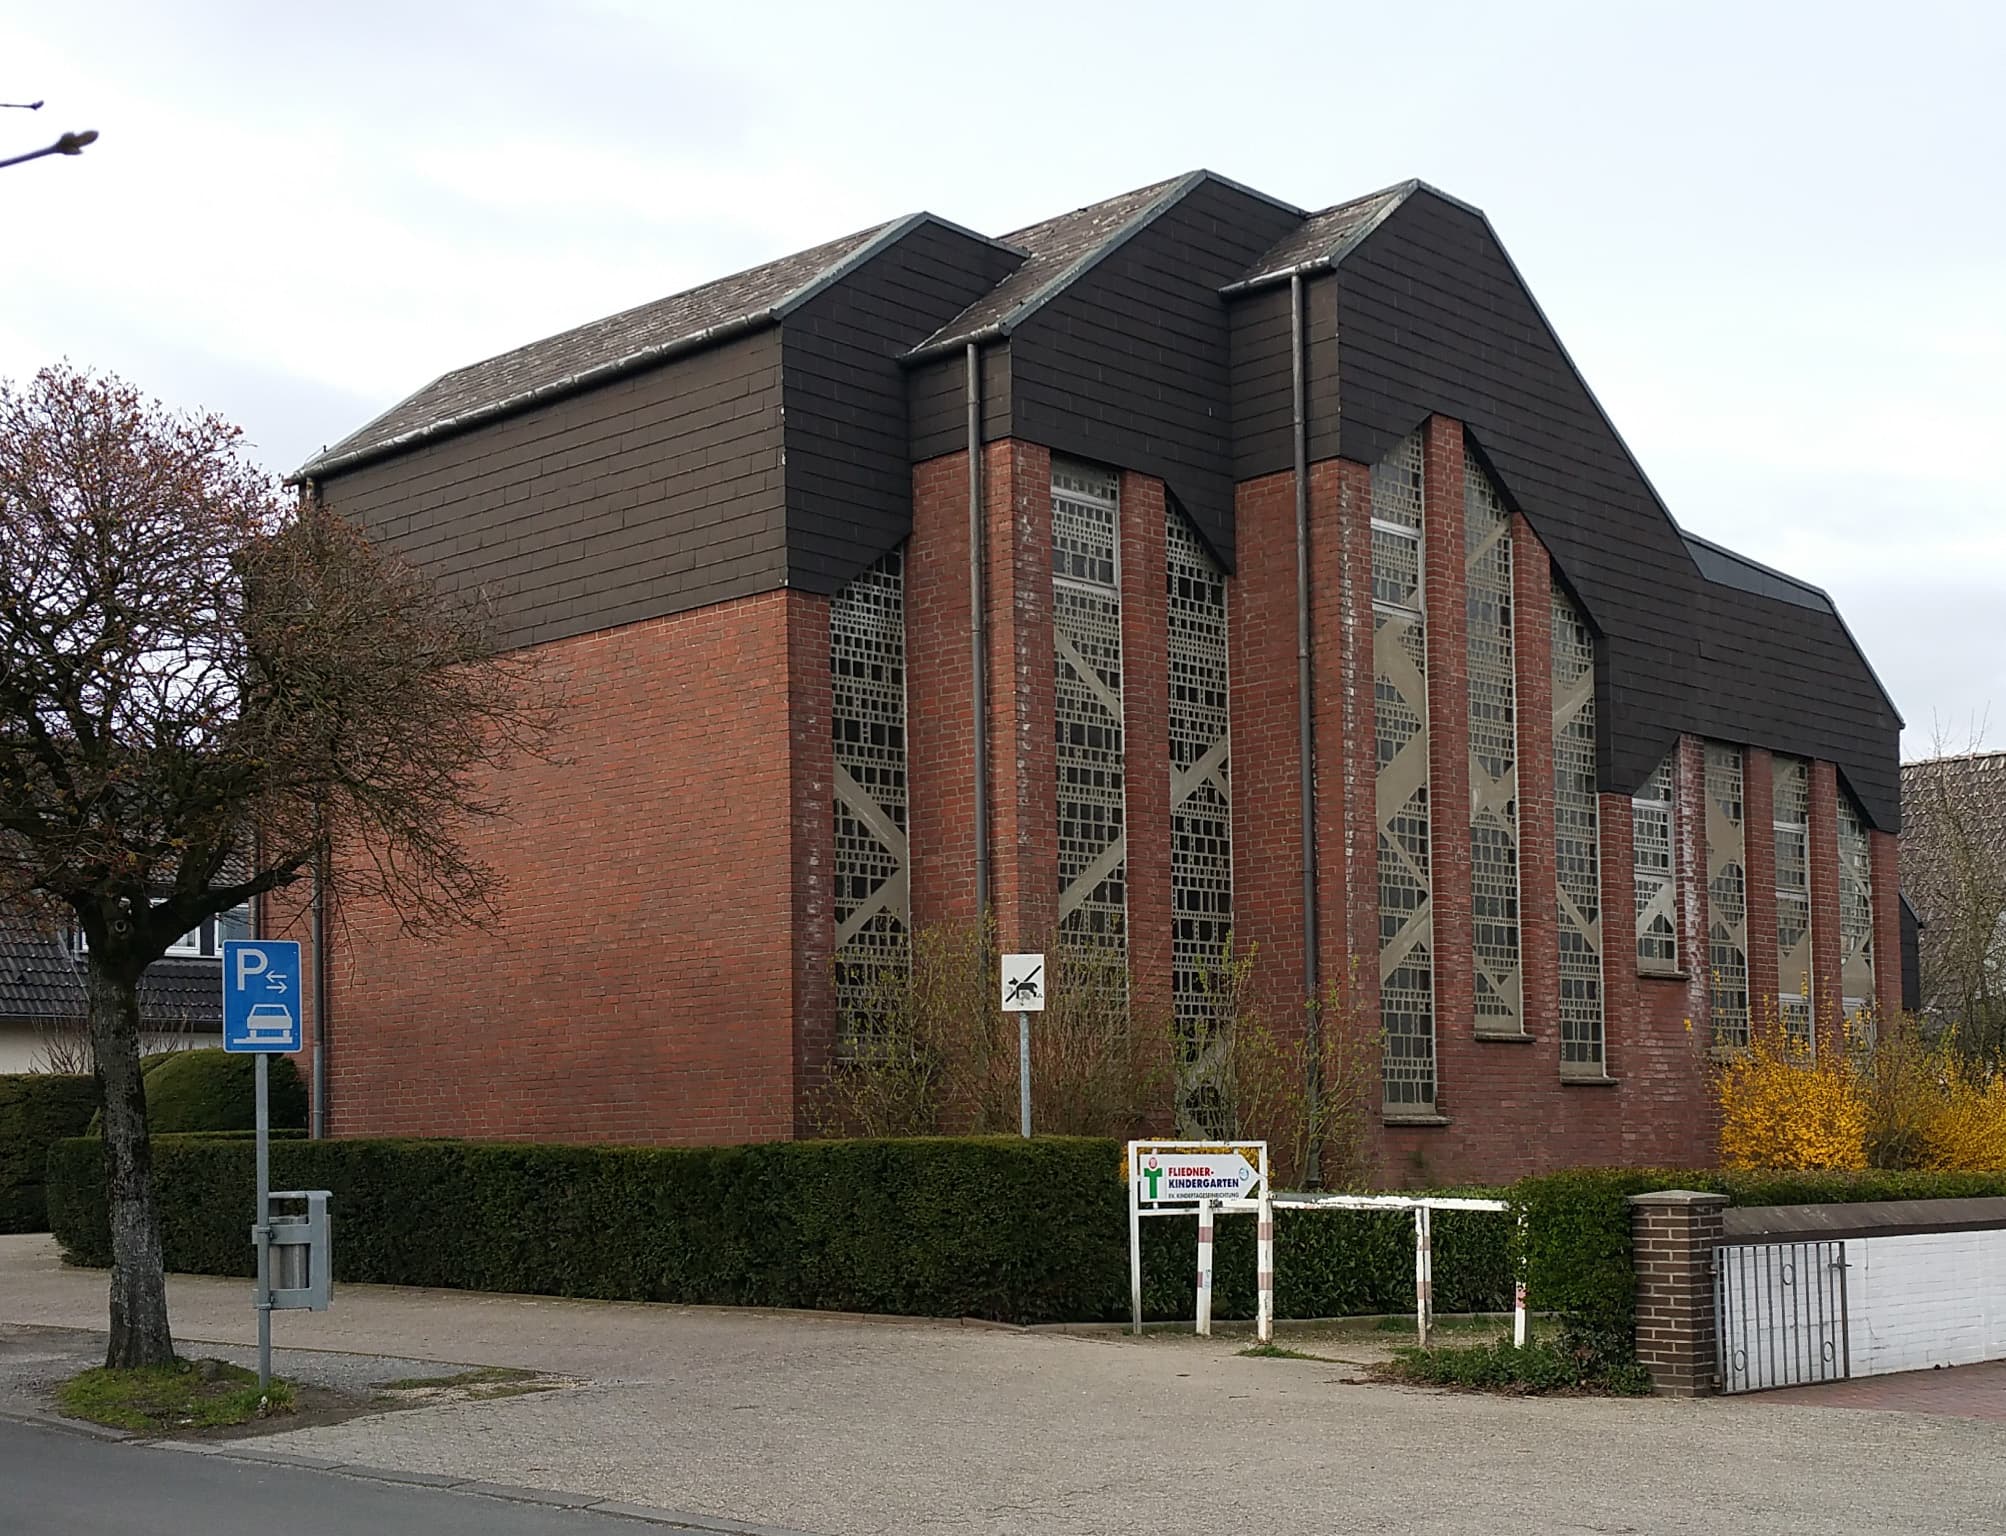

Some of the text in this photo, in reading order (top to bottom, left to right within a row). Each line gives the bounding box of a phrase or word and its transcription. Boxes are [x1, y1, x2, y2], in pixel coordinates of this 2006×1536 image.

[237, 948, 268, 991] P
[1168, 1167, 1214, 1177] FLIEDNER-
[1168, 1178, 1239, 1189] KINDERGARTEN
